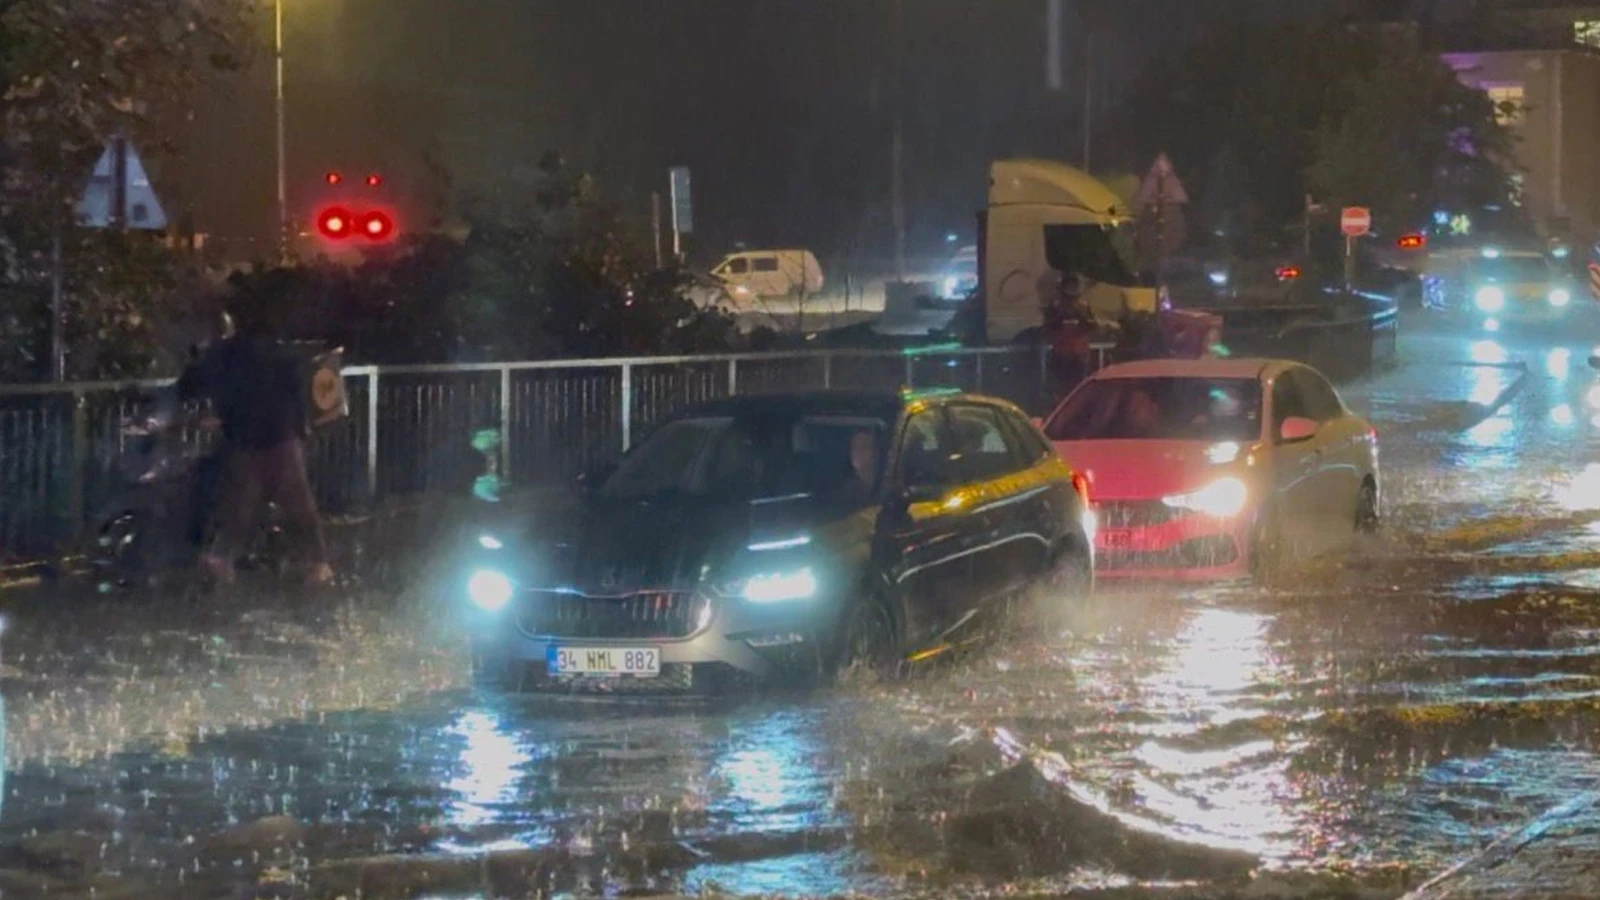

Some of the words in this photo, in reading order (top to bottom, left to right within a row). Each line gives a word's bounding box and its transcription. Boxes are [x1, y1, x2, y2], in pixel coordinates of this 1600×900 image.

[558, 651, 577, 670] 34
[587, 651, 617, 670] NML
[624, 651, 656, 671] 882
